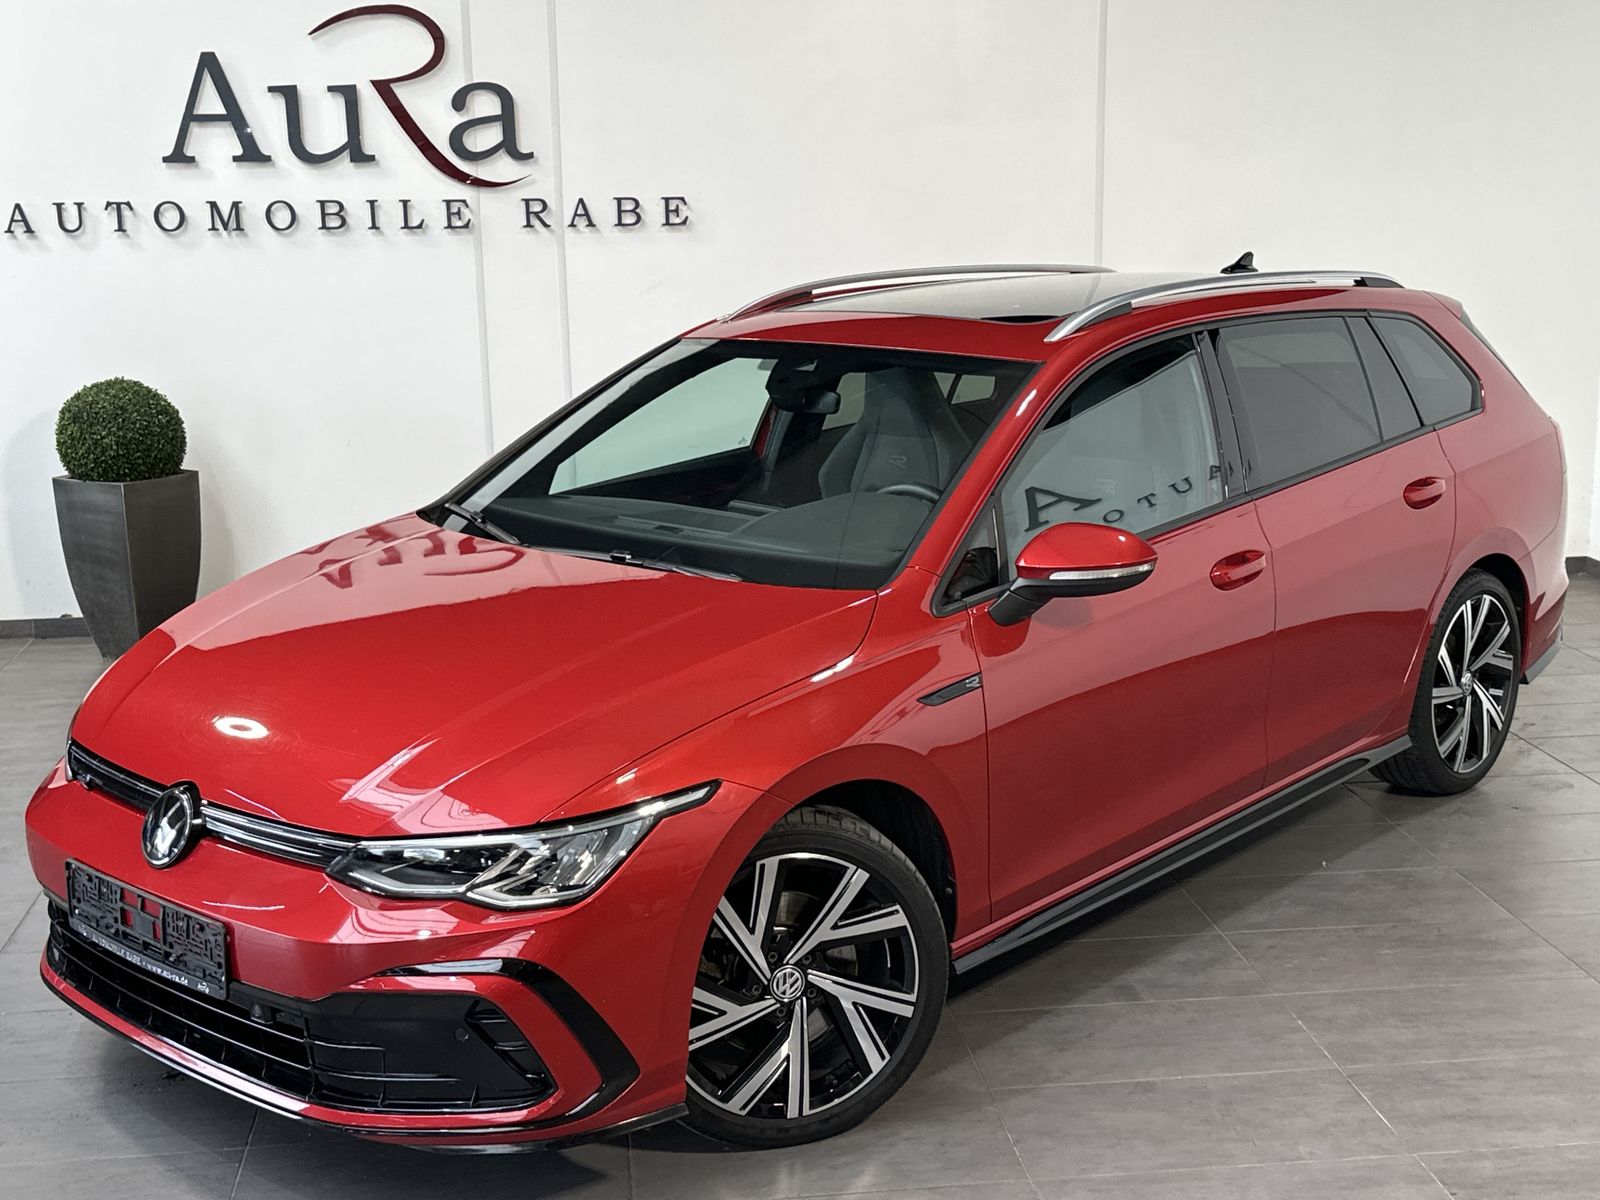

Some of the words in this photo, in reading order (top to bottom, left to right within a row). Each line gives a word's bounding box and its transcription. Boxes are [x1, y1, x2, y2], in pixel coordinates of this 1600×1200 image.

[161, 4, 535, 188] AuRa
[4, 199, 472, 235] AUTOMOBILE
[521, 196, 690, 229] RABE
